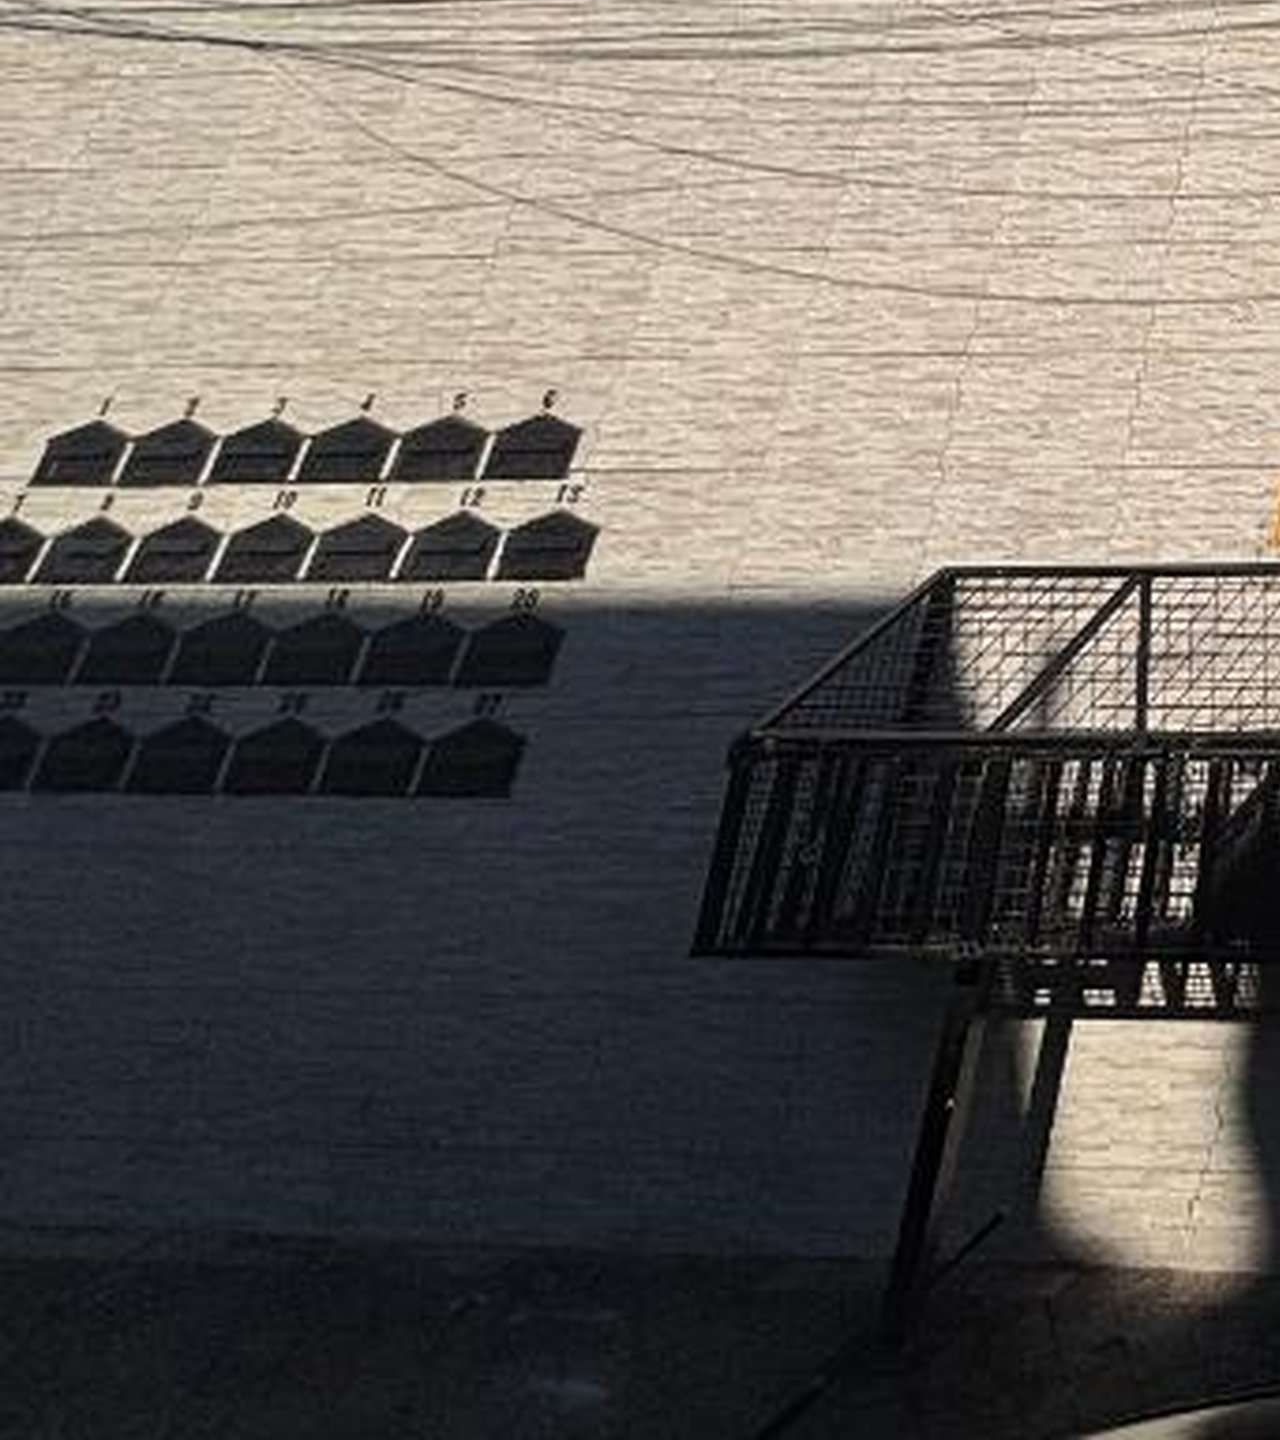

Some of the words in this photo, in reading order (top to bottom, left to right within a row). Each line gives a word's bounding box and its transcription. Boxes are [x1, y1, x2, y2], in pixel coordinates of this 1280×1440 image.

[188, 491, 203, 511] 9
[273, 490, 297, 511] 10
[365, 486, 387, 508] 11
[460, 487, 485, 508] 12
